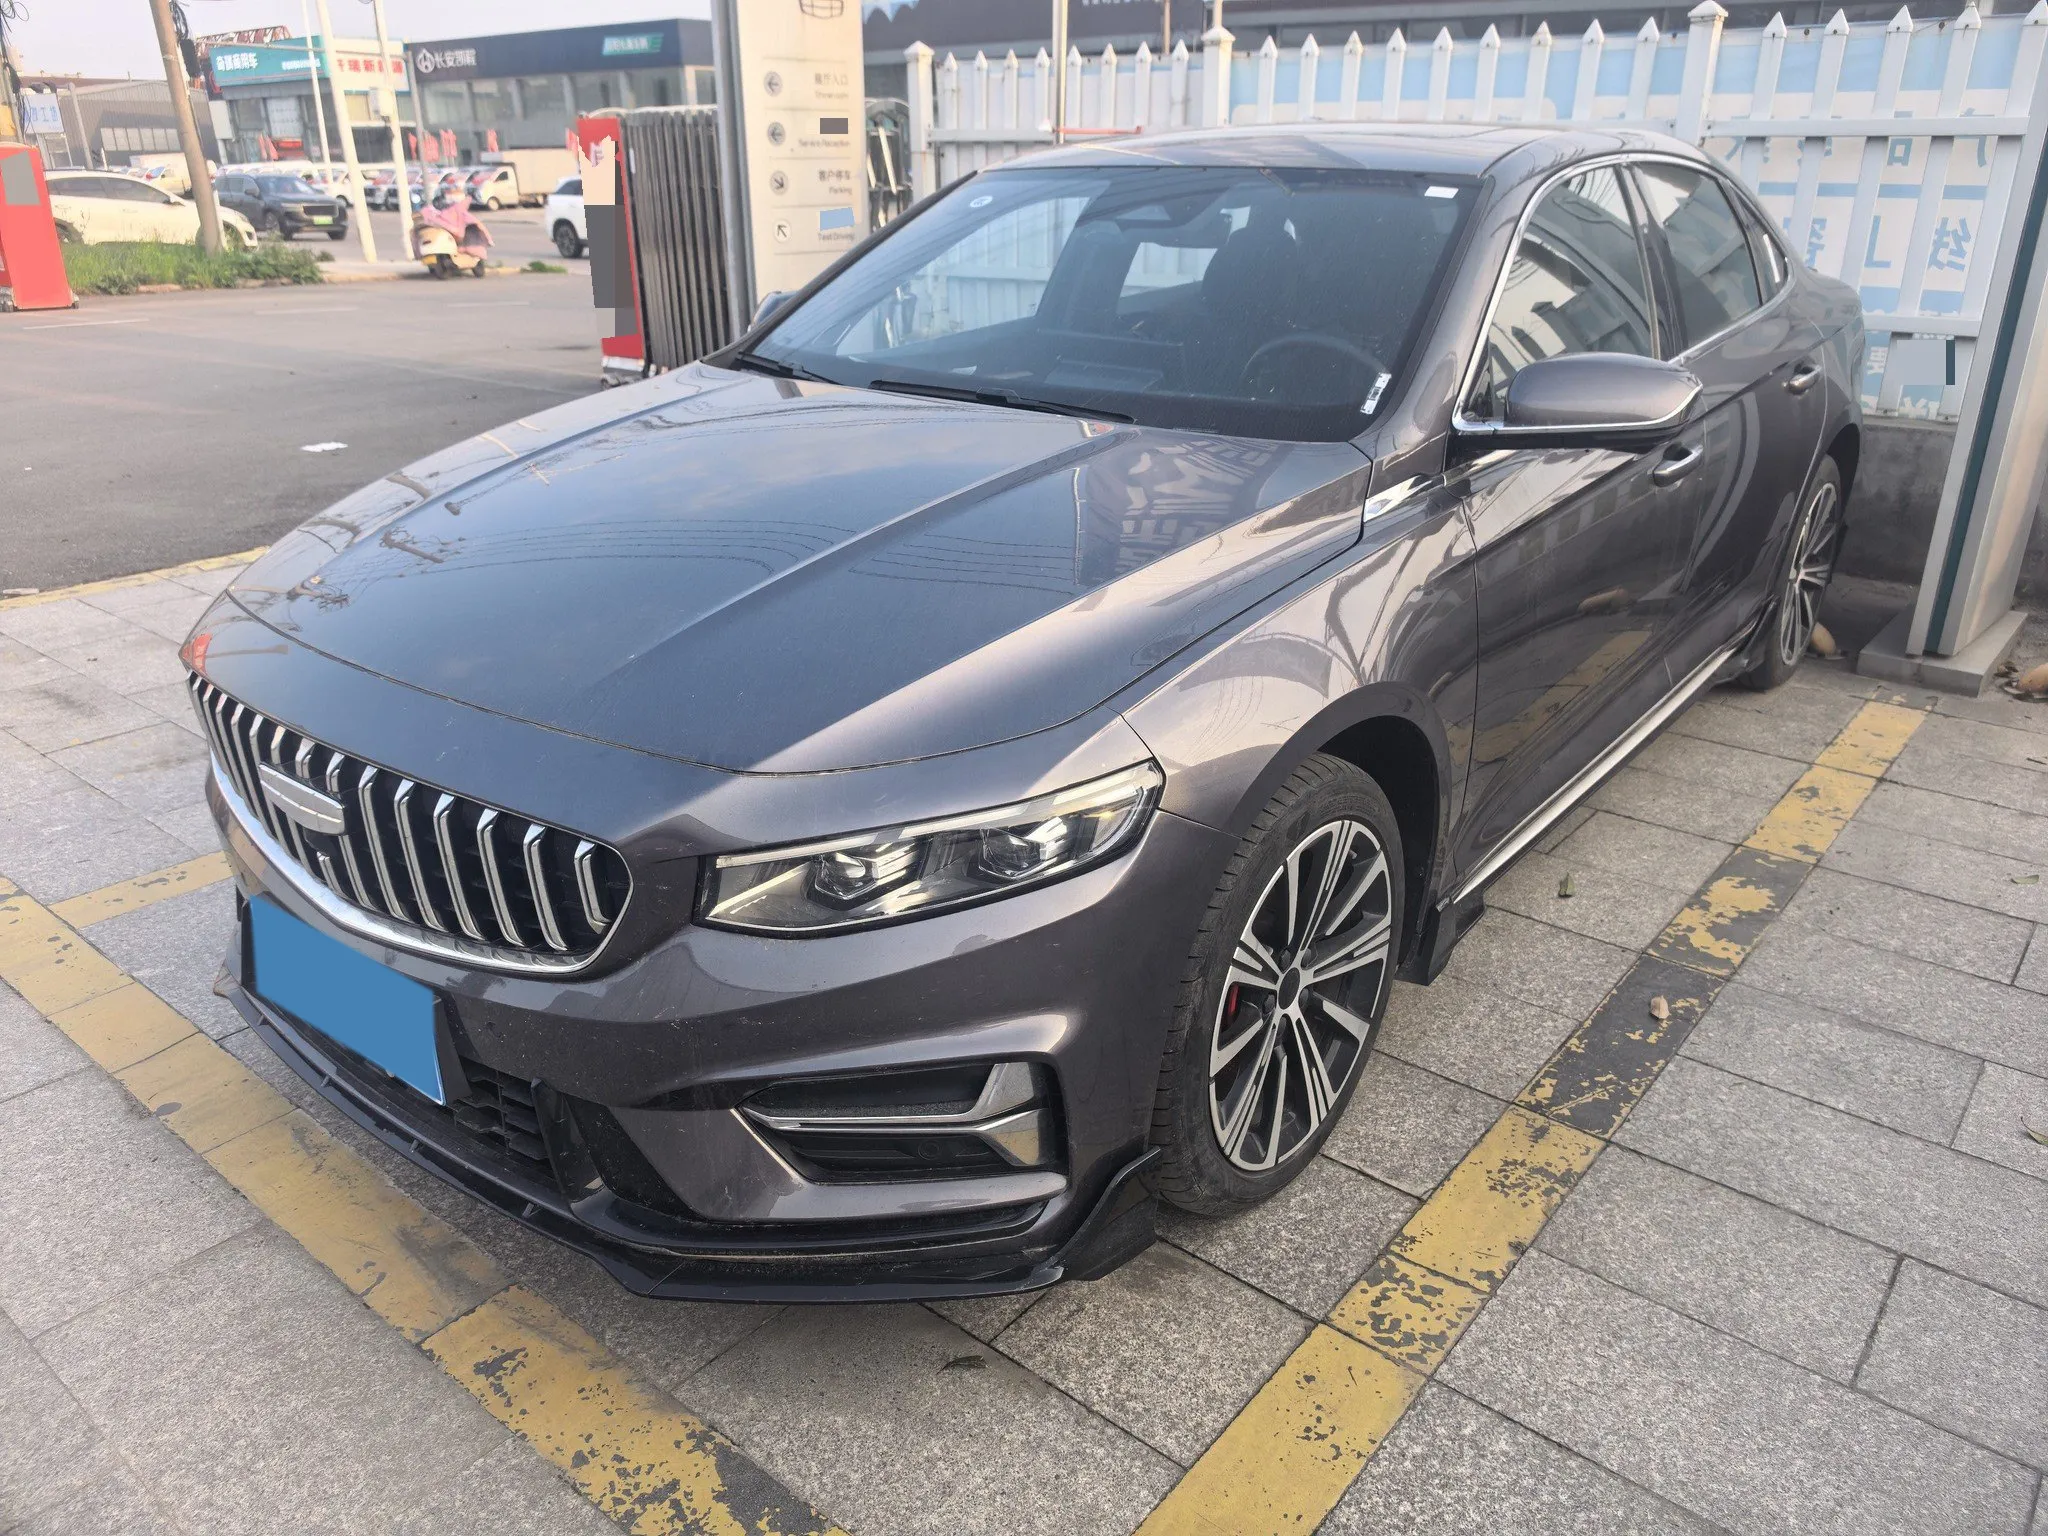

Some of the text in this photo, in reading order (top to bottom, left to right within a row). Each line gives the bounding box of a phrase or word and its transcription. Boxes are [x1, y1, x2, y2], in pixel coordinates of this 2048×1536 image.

[829, 186, 852, 195] Parking
[818, 232, 855, 242] Test Driving
